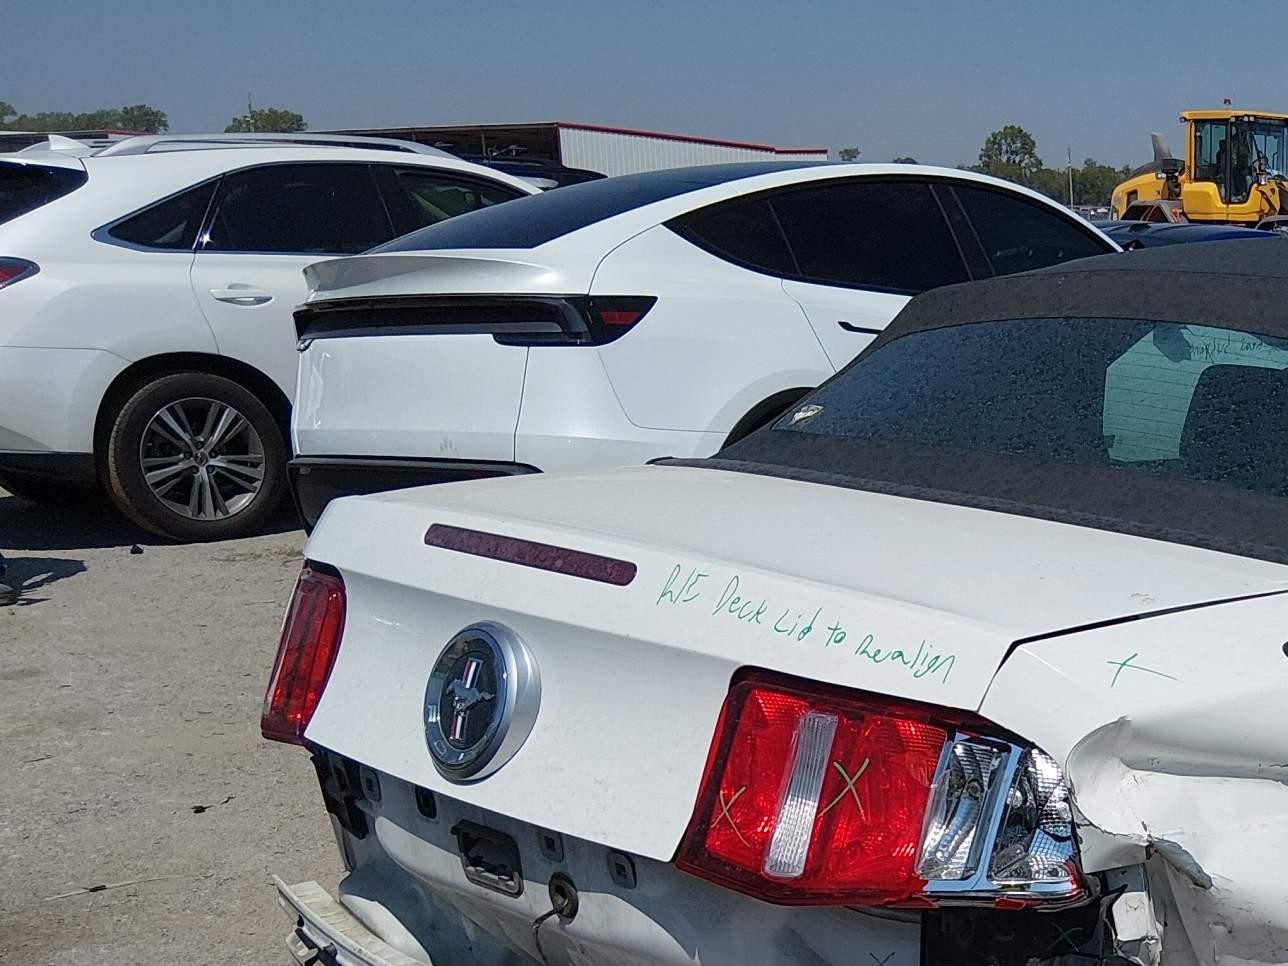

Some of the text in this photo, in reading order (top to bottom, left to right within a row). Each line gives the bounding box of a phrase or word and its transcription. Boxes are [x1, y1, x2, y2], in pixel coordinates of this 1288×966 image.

[712, 575, 768, 625] Deck
[773, 607, 823, 642] Lid
[826, 611, 847, 647] to
